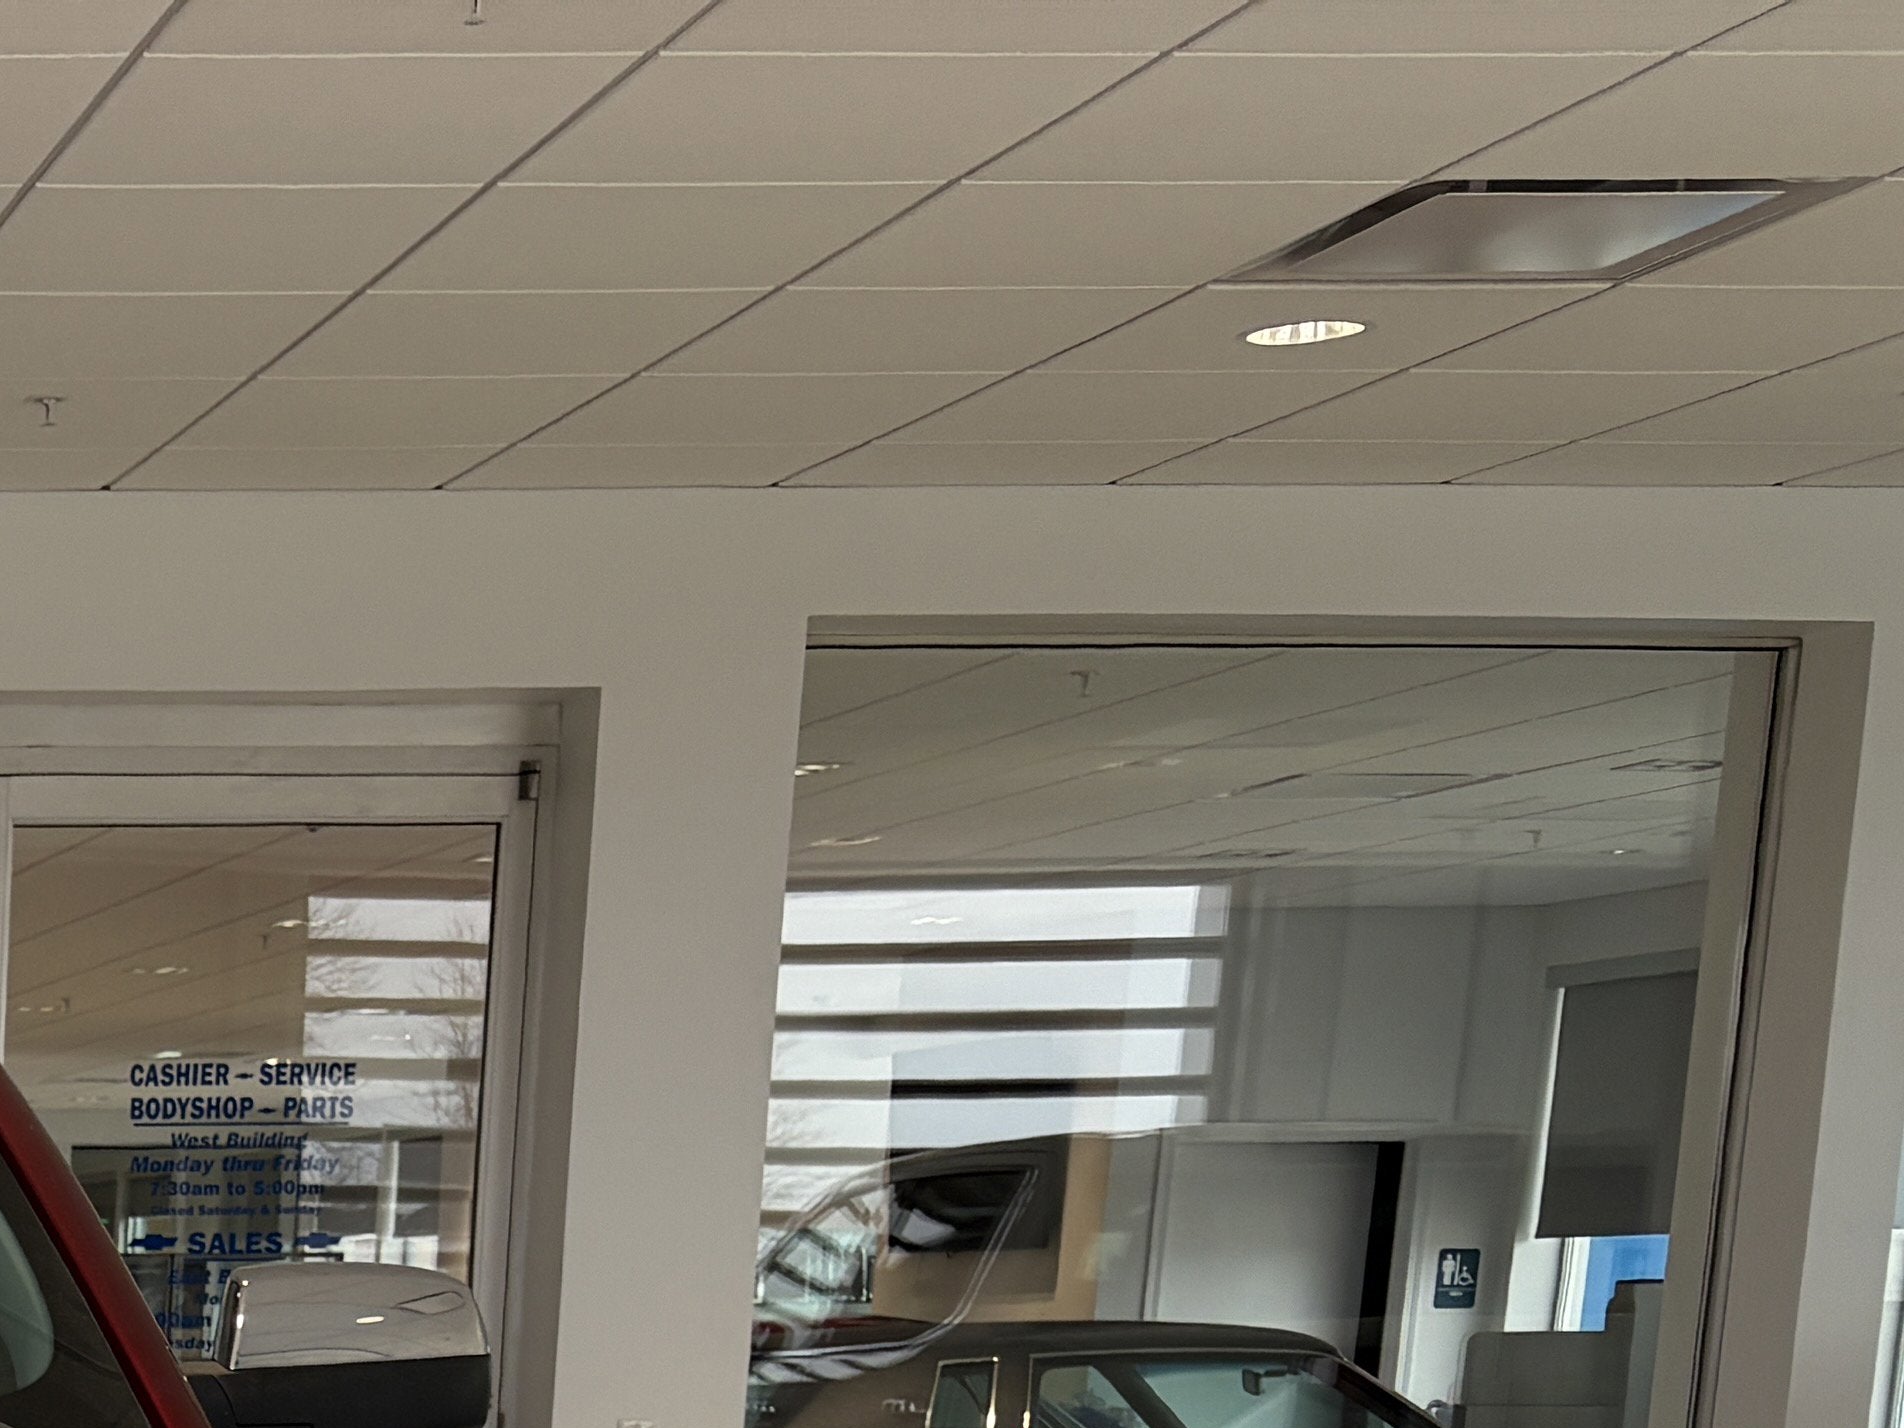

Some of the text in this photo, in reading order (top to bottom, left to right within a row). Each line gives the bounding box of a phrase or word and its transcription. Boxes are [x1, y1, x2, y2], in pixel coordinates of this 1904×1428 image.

[130, 1062, 357, 1087] CASHIER SERVICE
[130, 1096, 354, 1120] BODYSHOP PARTS
[170, 1130, 310, 1153] West Building
[130, 1154, 340, 1176] Monday thru Friday
[150, 1179, 325, 1199] 7:30am to 5:00pm
[187, 1232, 283, 1255] SALES
